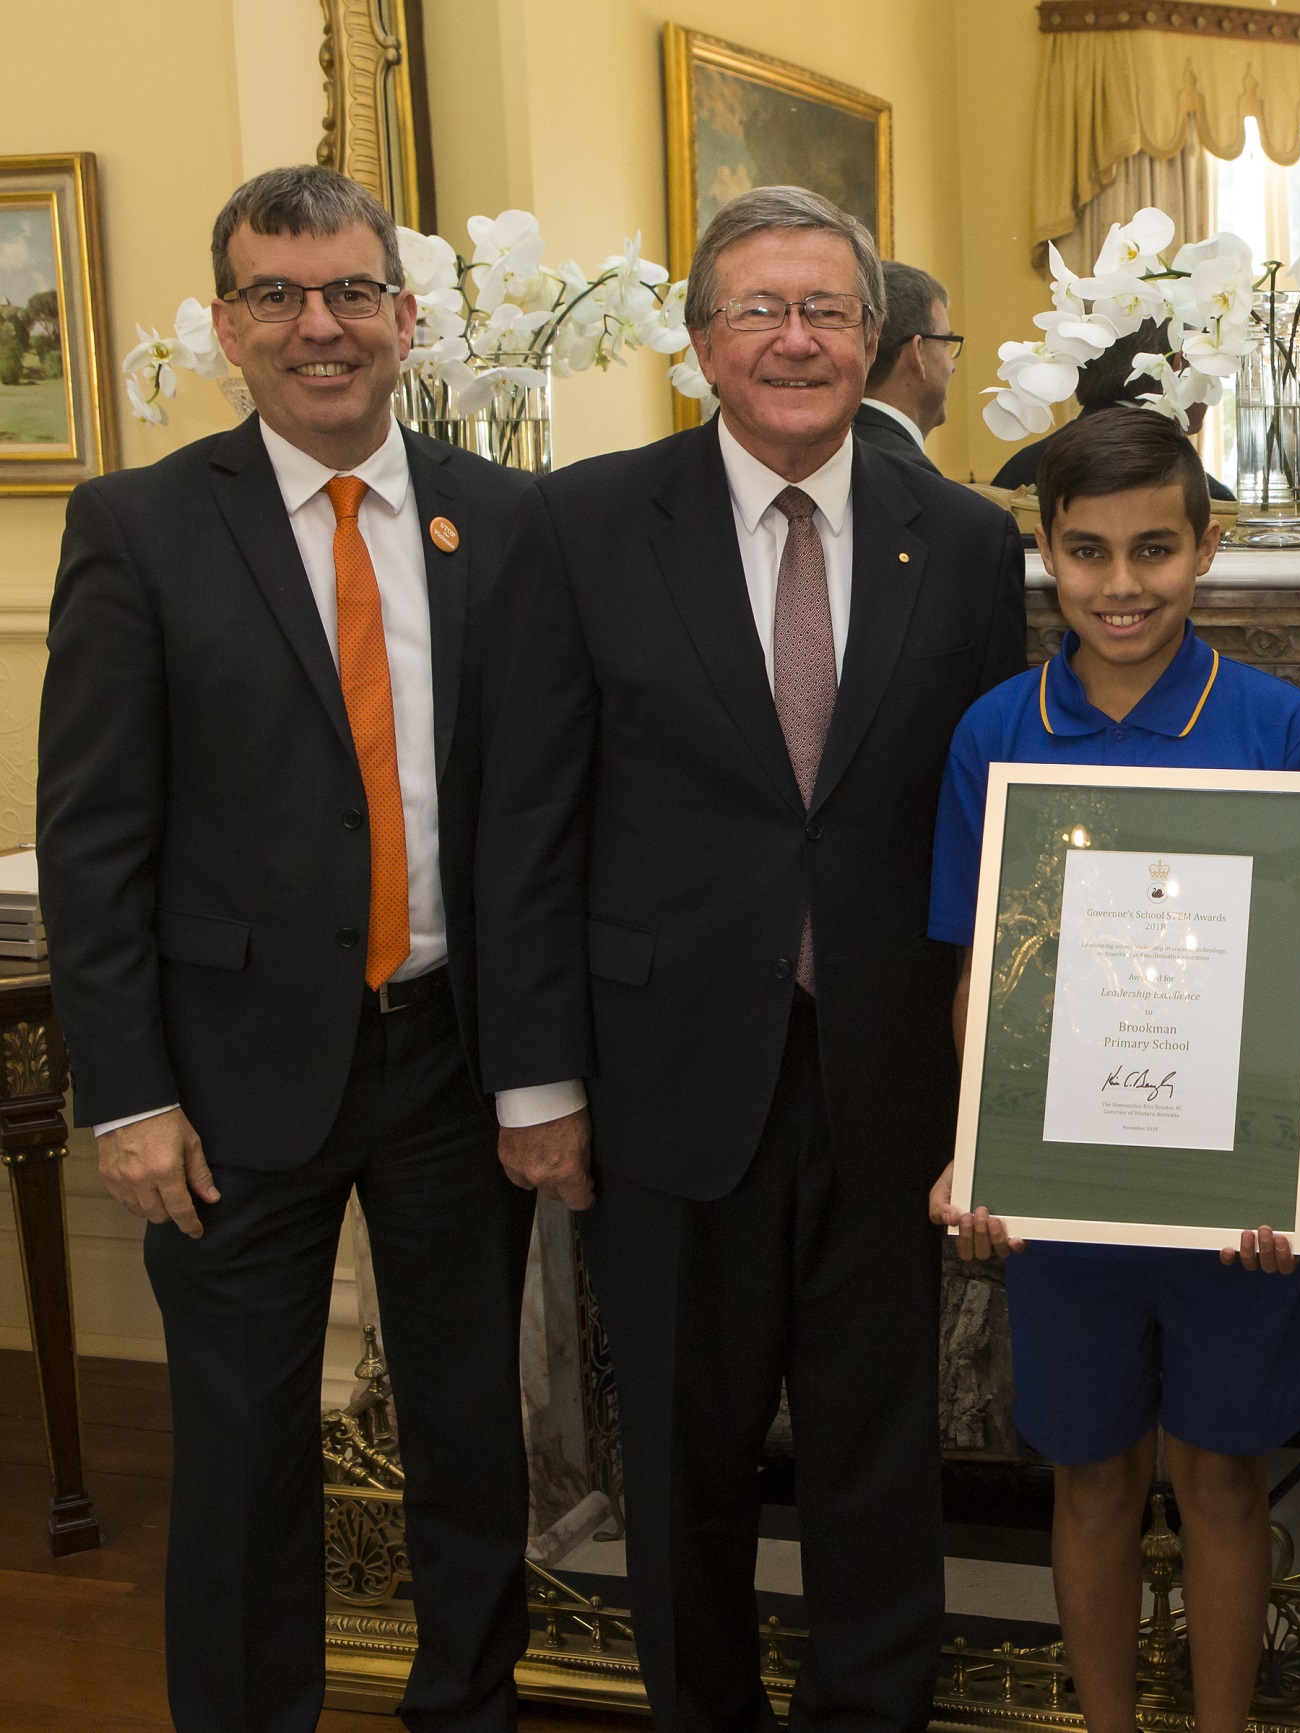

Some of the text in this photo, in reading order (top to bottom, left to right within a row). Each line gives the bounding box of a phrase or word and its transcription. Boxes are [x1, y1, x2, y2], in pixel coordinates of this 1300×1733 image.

[440, 522, 456, 537] STOP
[1086, 908, 1227, 923] Governor's School STEM Awards
[1144, 922, 1166, 931] 2018
[1164, 974, 1176, 982] for
[1100, 988, 1201, 1002] Leadership Excellence
[1145, 1008, 1153, 1016] to
[1118, 1022, 1177, 1035] Brookman
[1104, 1036, 1190, 1052] Primary School
